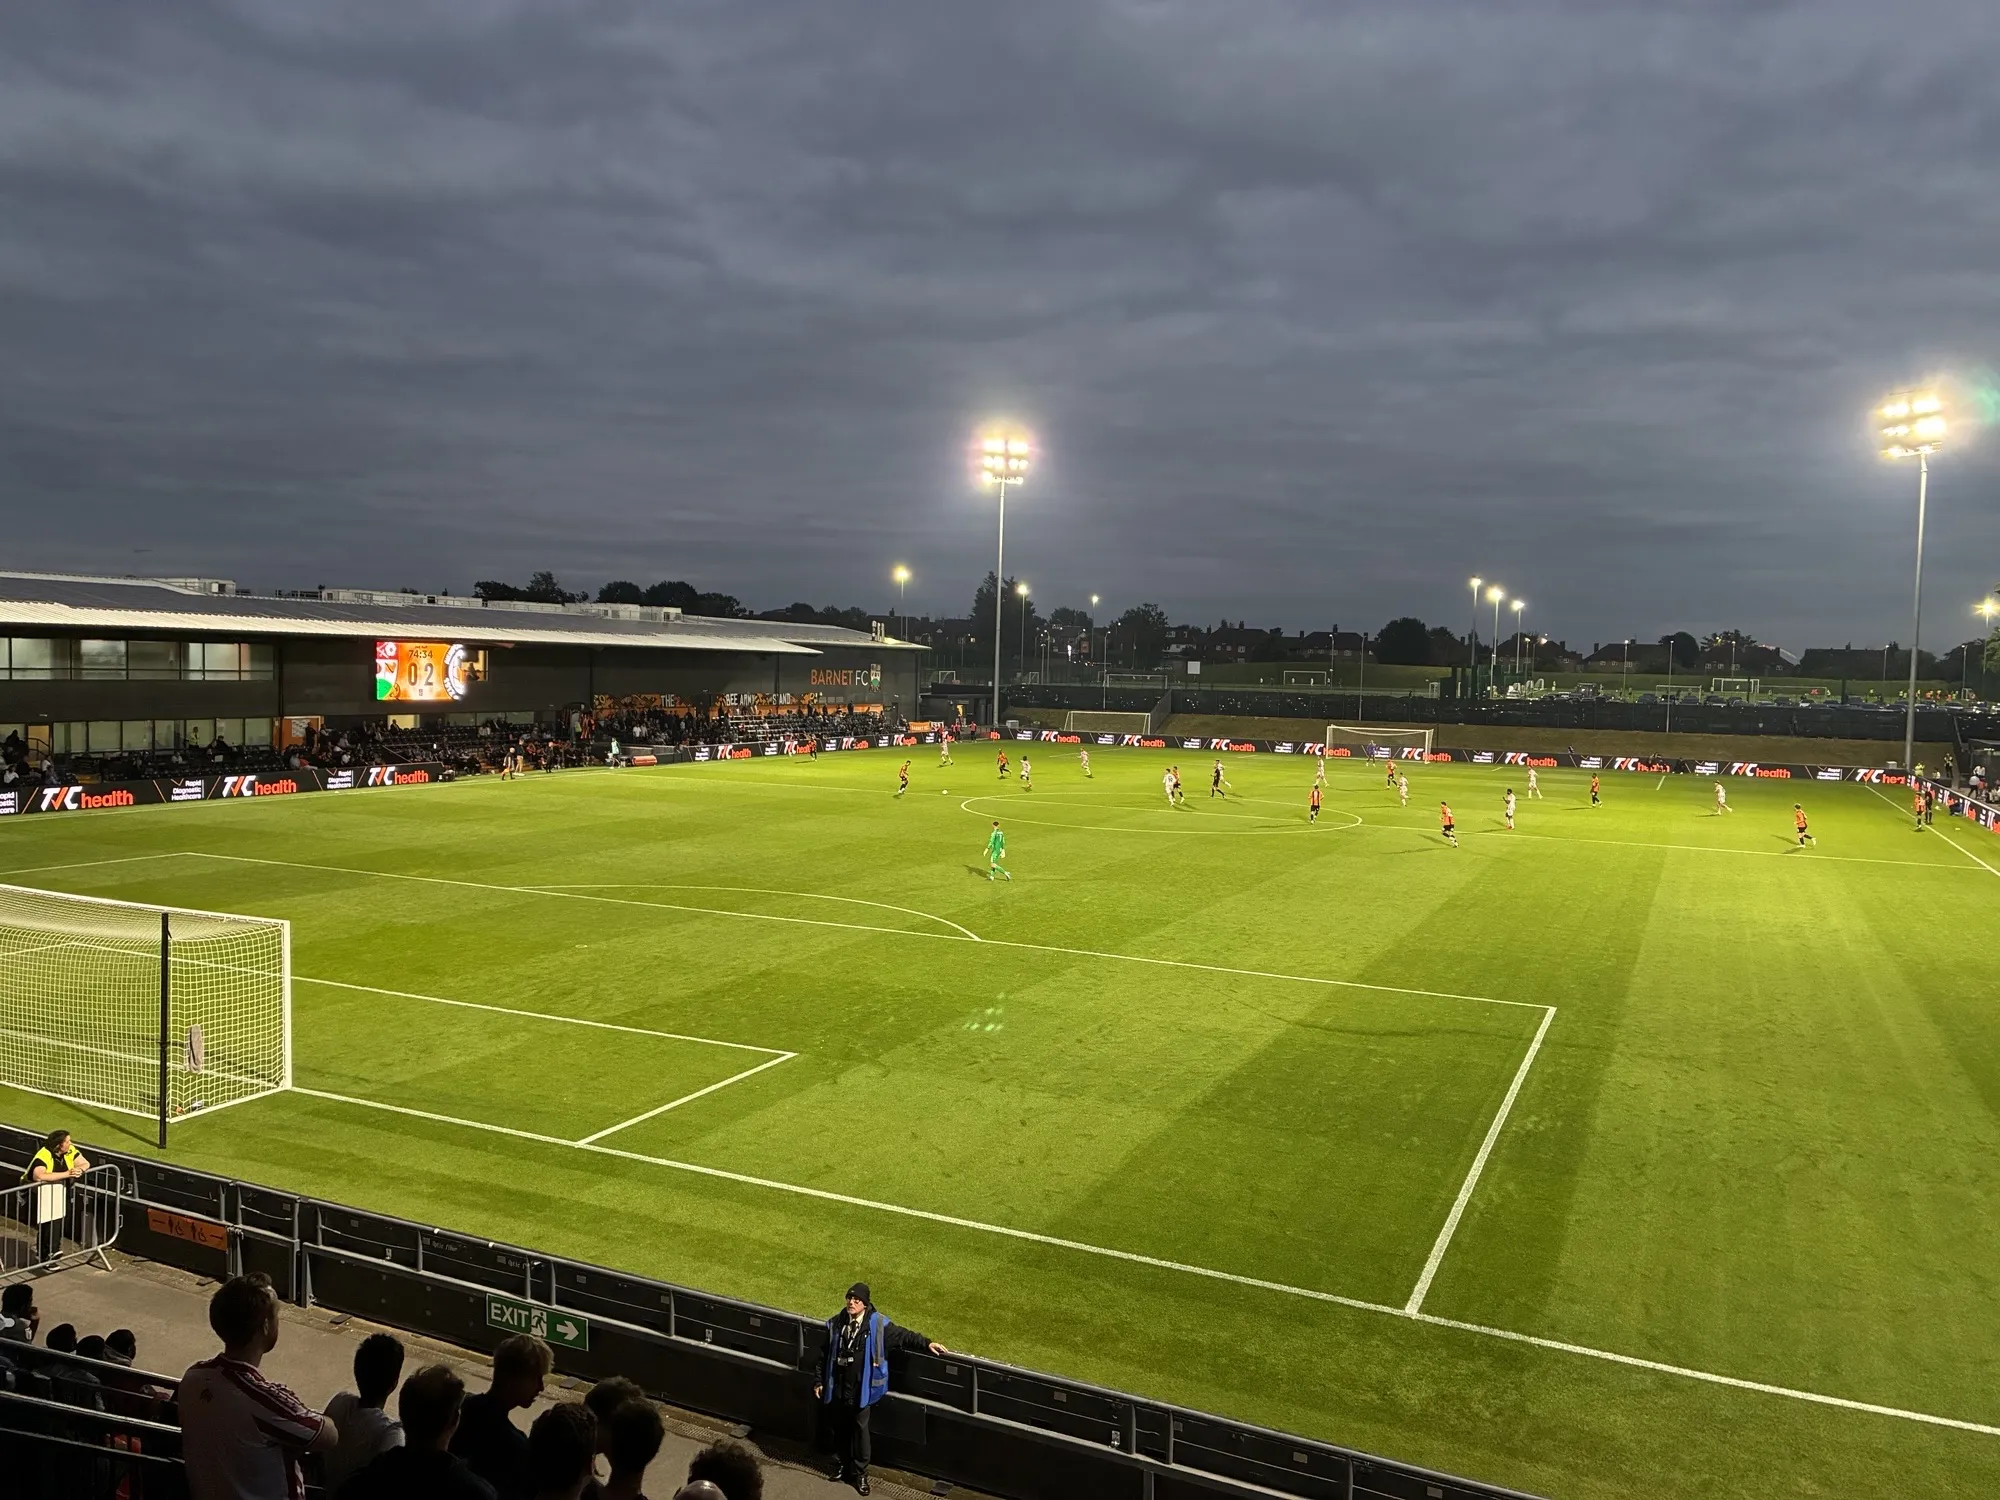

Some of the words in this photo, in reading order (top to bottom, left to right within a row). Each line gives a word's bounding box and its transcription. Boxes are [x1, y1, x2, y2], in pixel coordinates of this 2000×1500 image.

[409, 649, 433, 659] 74:34
[408, 662, 417, 686] 0
[424, 662, 433, 686] 2
[811, 668, 853, 686] BARNET
[855, 670, 868, 686] FC
[660, 694, 675, 708] THE
[725, 693, 738, 706] BEE
[772, 692, 791, 706] SAND
[1057, 735, 1080, 744] health
[1140, 739, 1166, 748] health
[1229, 743, 1256, 752] health
[1526, 757, 1557, 767] health
[394, 769, 429, 785] health
[1755, 767, 1791, 779] health
[254, 779, 297, 796] health
[81, 790, 134, 808] health
[490, 1302, 529, 1328] EXIT
